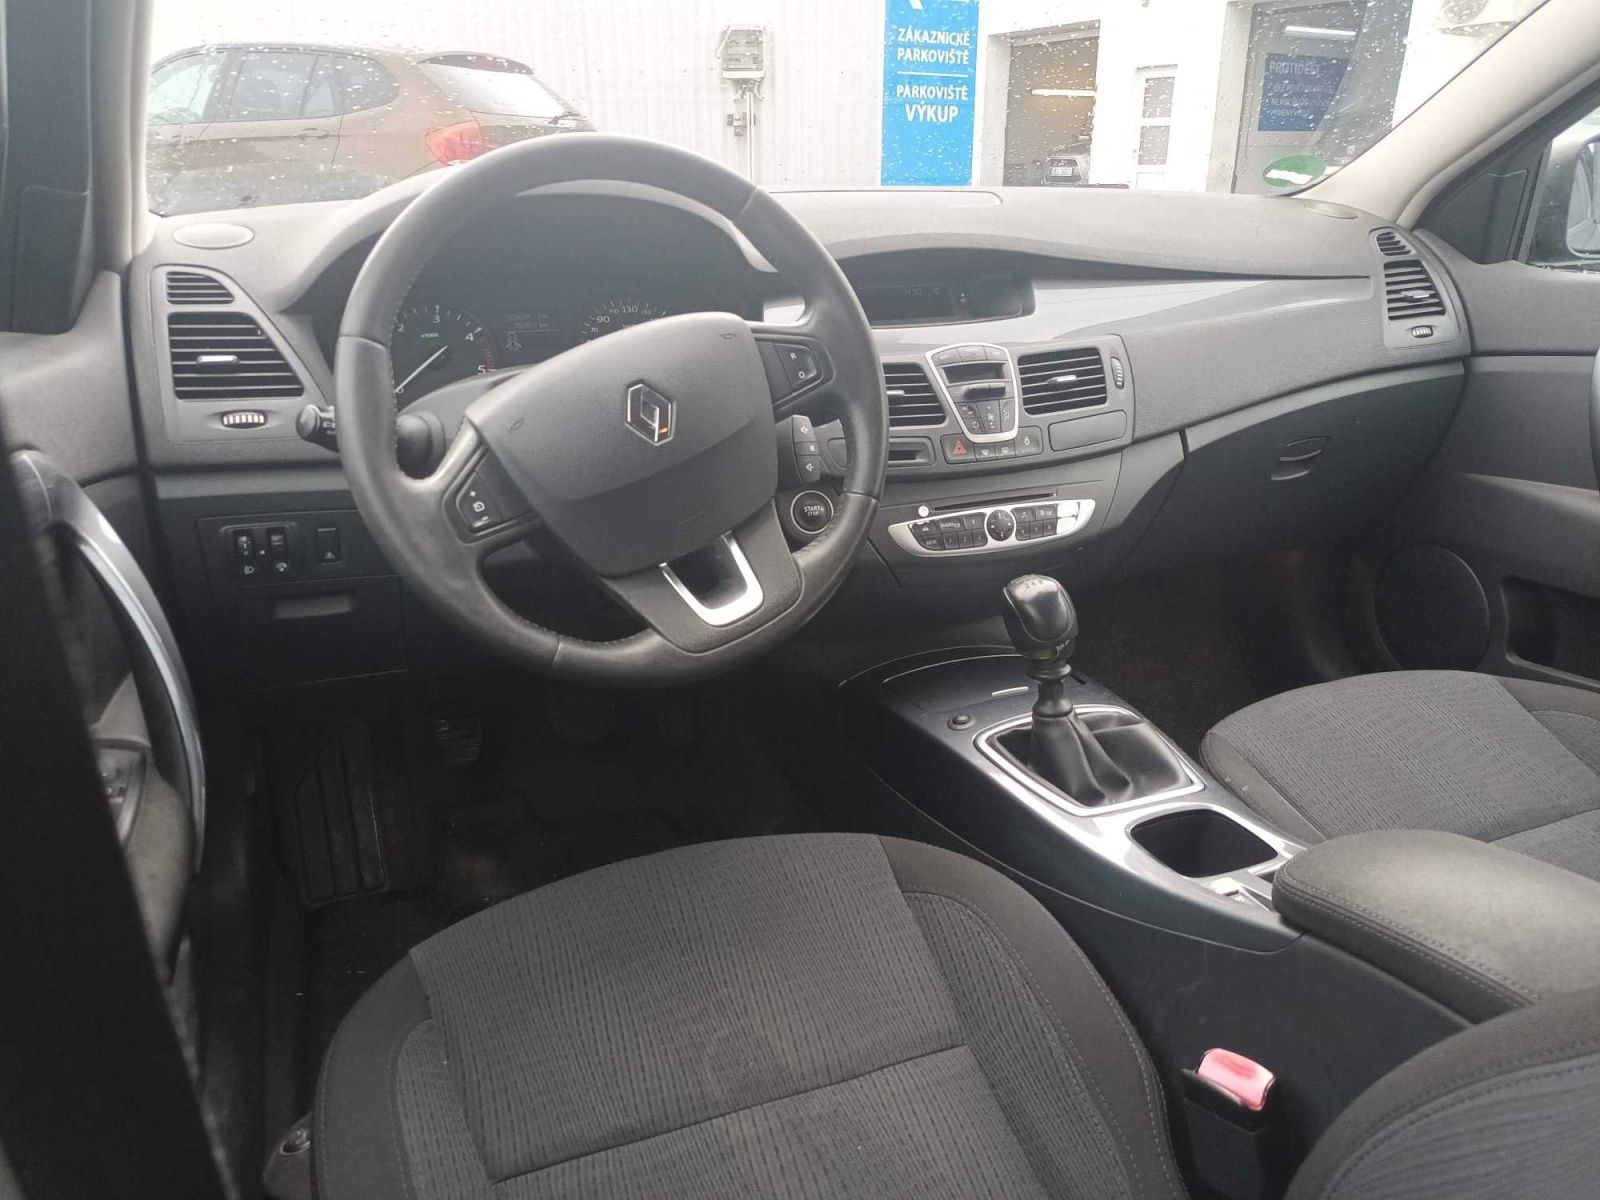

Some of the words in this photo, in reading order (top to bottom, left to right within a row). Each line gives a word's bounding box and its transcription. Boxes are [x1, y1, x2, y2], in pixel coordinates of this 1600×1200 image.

[896, 25, 970, 46] ZÁKAZNICKÉ
[896, 47, 970, 65] PARKOVIŠTĚ
[896, 84, 969, 101] PARKOVIŠTĚ
[904, 102, 959, 123] VÝKUP
[622, 305, 638, 314] 130
[432, 315, 441, 324] 3
[596, 315, 610, 324] 90
[464, 332, 474, 342] 4
[477, 364, 487, 375] 5
[803, 504, 820, 513] START
